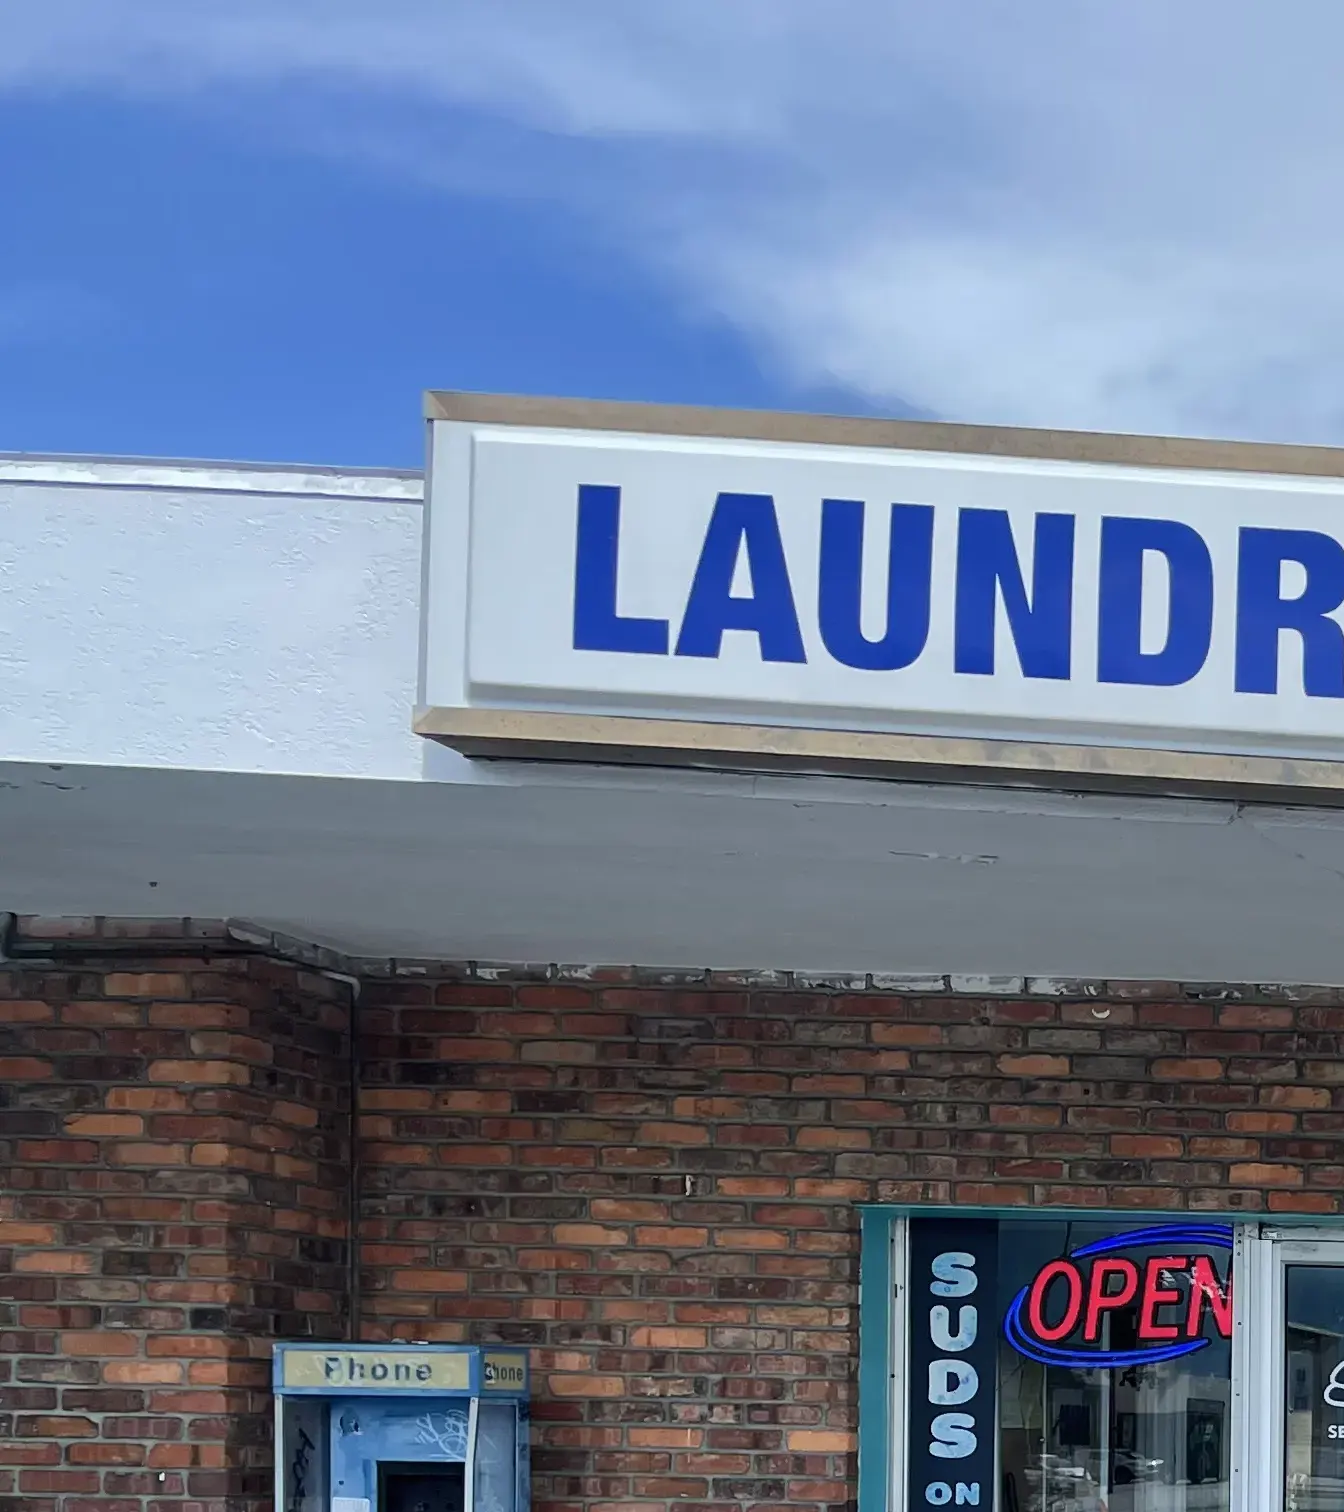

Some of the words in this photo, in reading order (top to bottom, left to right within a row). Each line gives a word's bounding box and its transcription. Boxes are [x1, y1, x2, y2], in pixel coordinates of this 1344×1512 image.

[1028, 1256, 1233, 1341] OPEN
[928, 1252, 979, 1459] SUDS
[925, 1481, 980, 1506] ON
